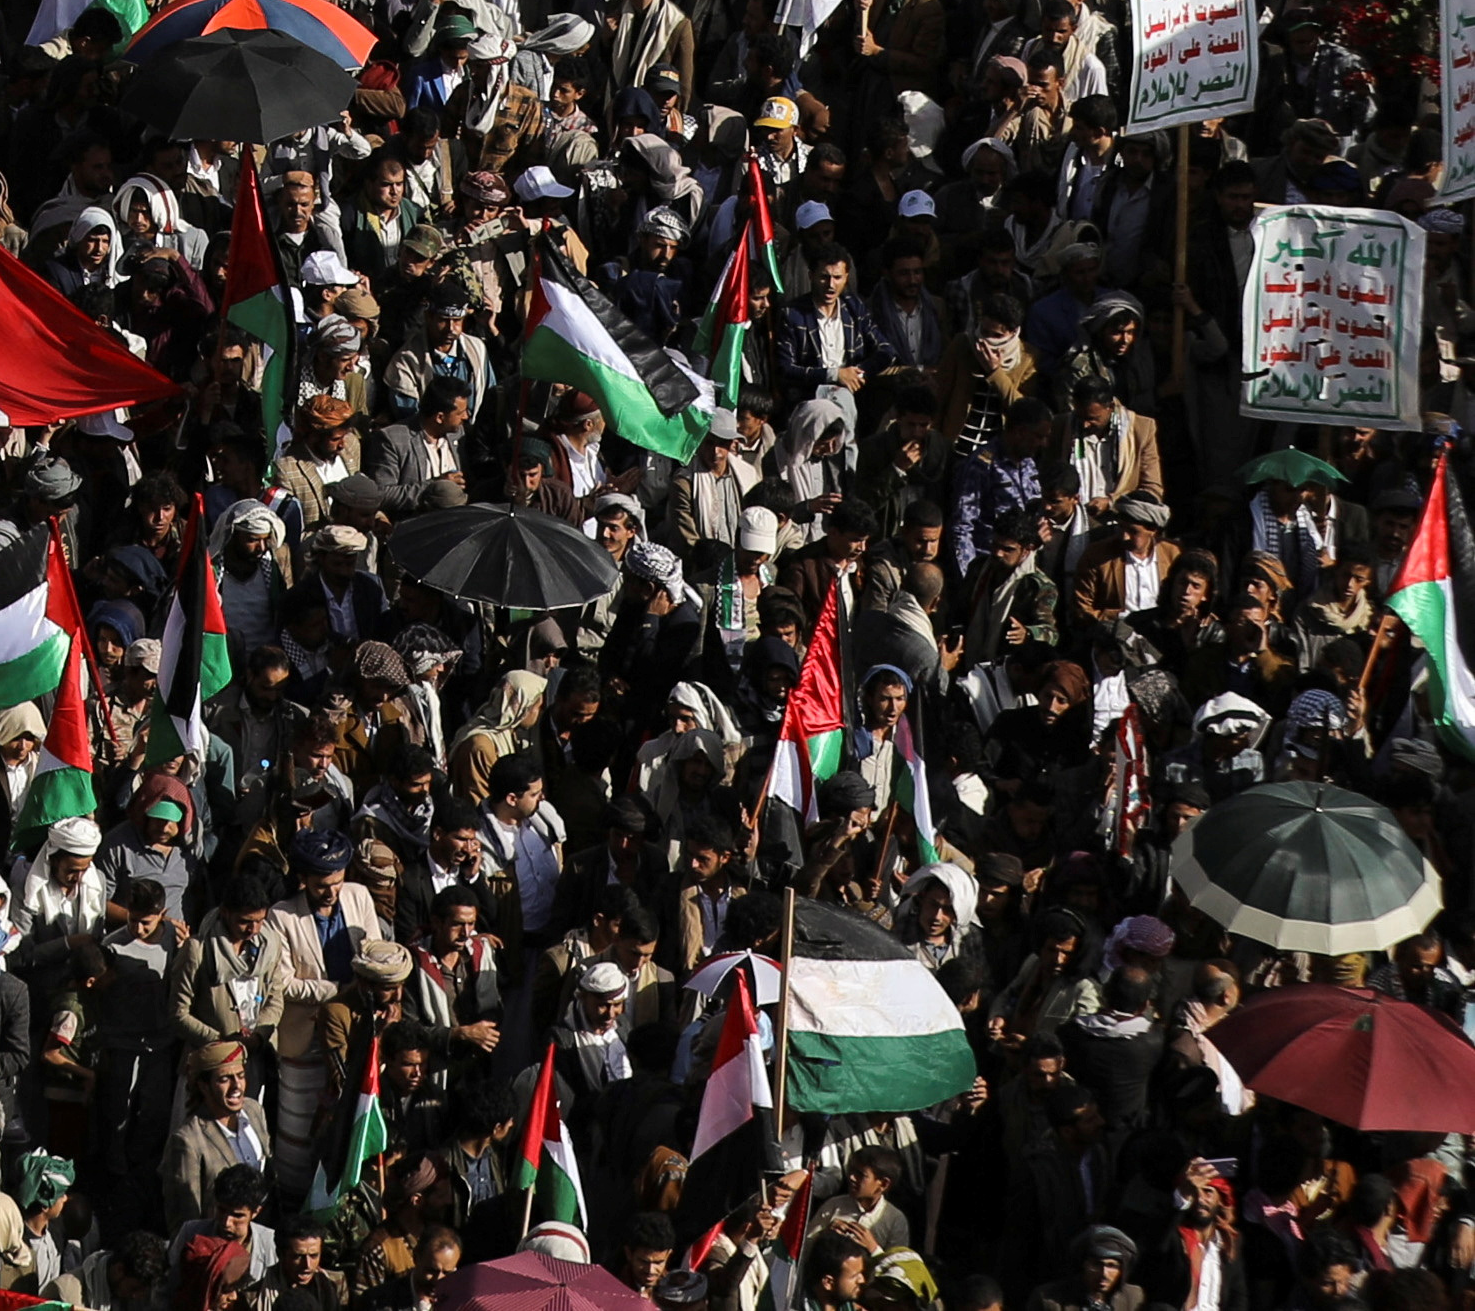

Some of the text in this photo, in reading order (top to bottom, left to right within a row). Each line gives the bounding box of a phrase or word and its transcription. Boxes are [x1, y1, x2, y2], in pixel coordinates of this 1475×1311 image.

[1207, 29, 1244, 55] اللعنة
[1143, 44, 1174, 69] اليهود
[1193, 53, 1244, 97] النصر
